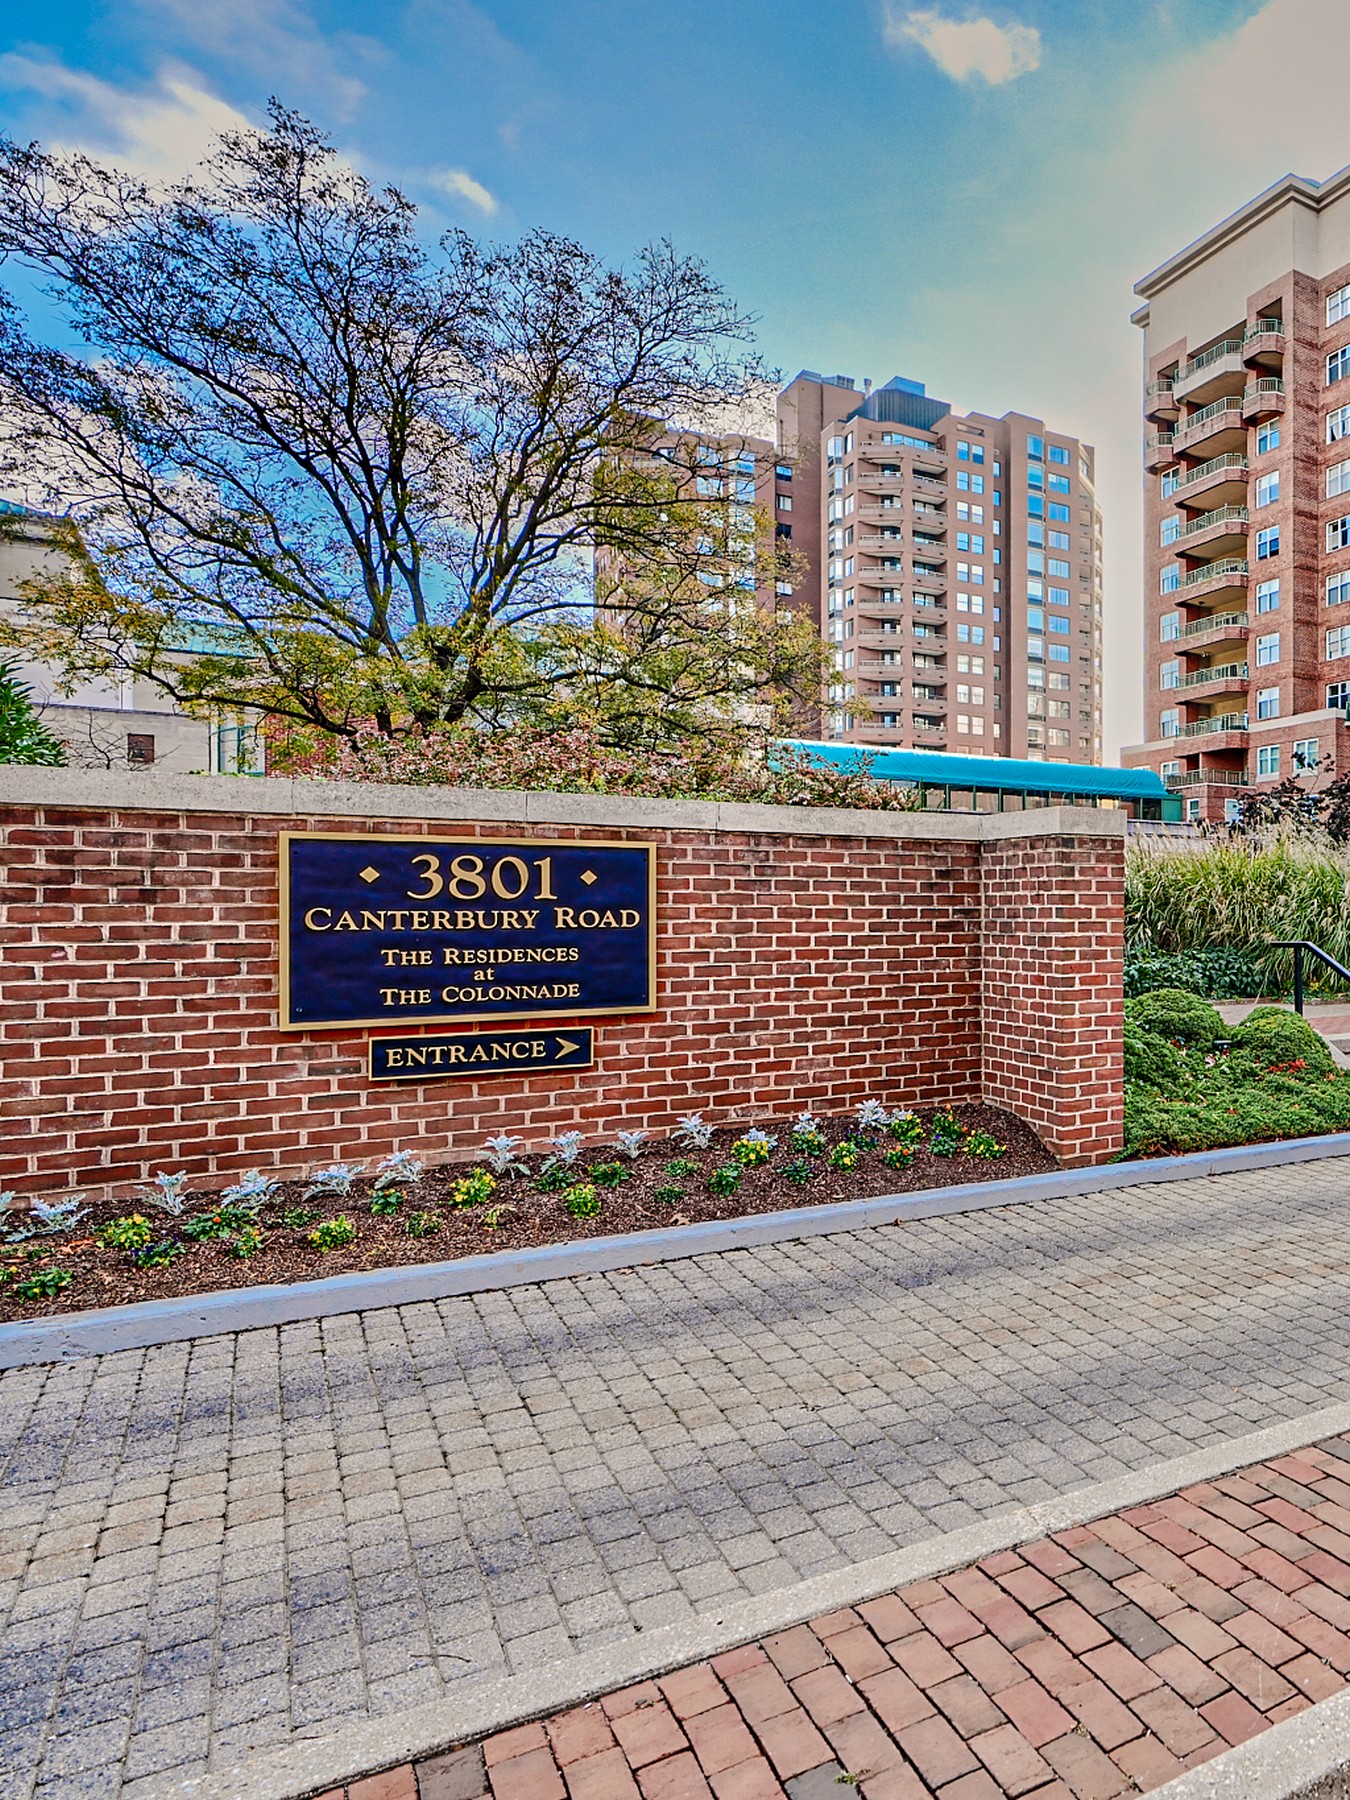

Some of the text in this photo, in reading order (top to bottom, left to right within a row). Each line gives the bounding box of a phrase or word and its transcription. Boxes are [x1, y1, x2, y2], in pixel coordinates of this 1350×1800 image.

[406, 853, 558, 900] 3801
[304, 906, 641, 932] CANTERBURY ROAD
[380, 947, 579, 966] THE RESIDENCES
[473, 967, 495, 981] at
[379, 983, 580, 1006] THE COLONNADE
[385, 1040, 547, 1068] ENTRANCE
